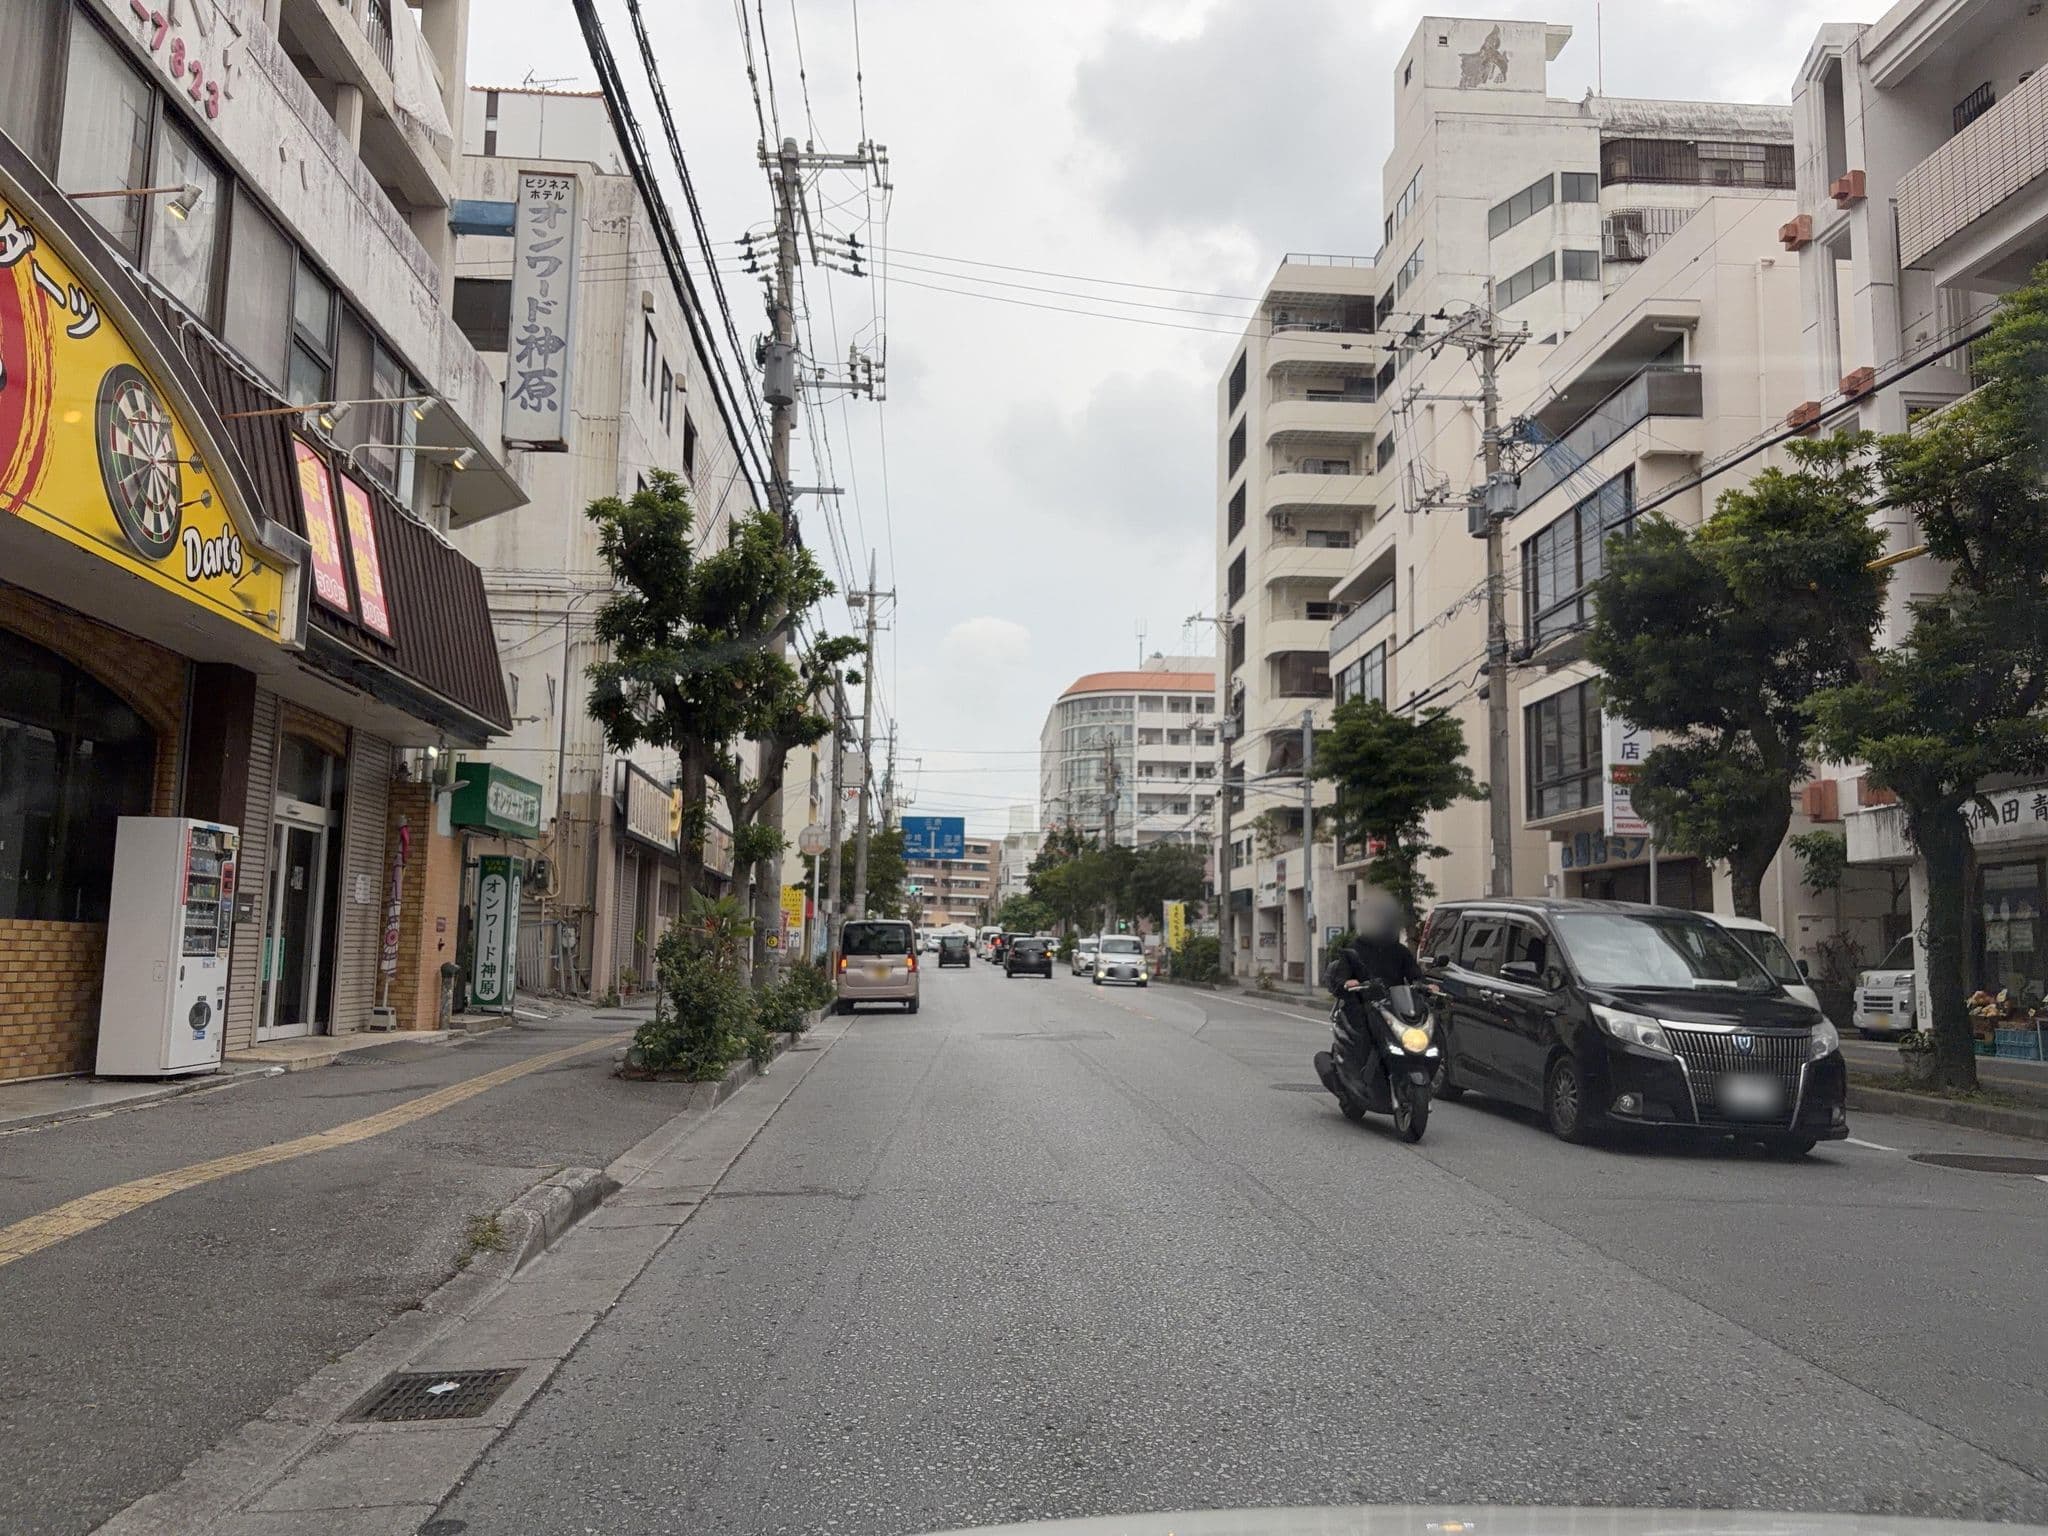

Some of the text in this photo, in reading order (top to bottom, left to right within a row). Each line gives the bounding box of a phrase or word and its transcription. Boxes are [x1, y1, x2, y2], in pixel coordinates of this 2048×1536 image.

[525, 178, 570, 190] ビジネス
[530, 190, 565, 200] ホテル
[510, 200, 567, 412] オンワード神原
[183, 524, 242, 582] Darts
[479, 879, 501, 996] オンワード神原
